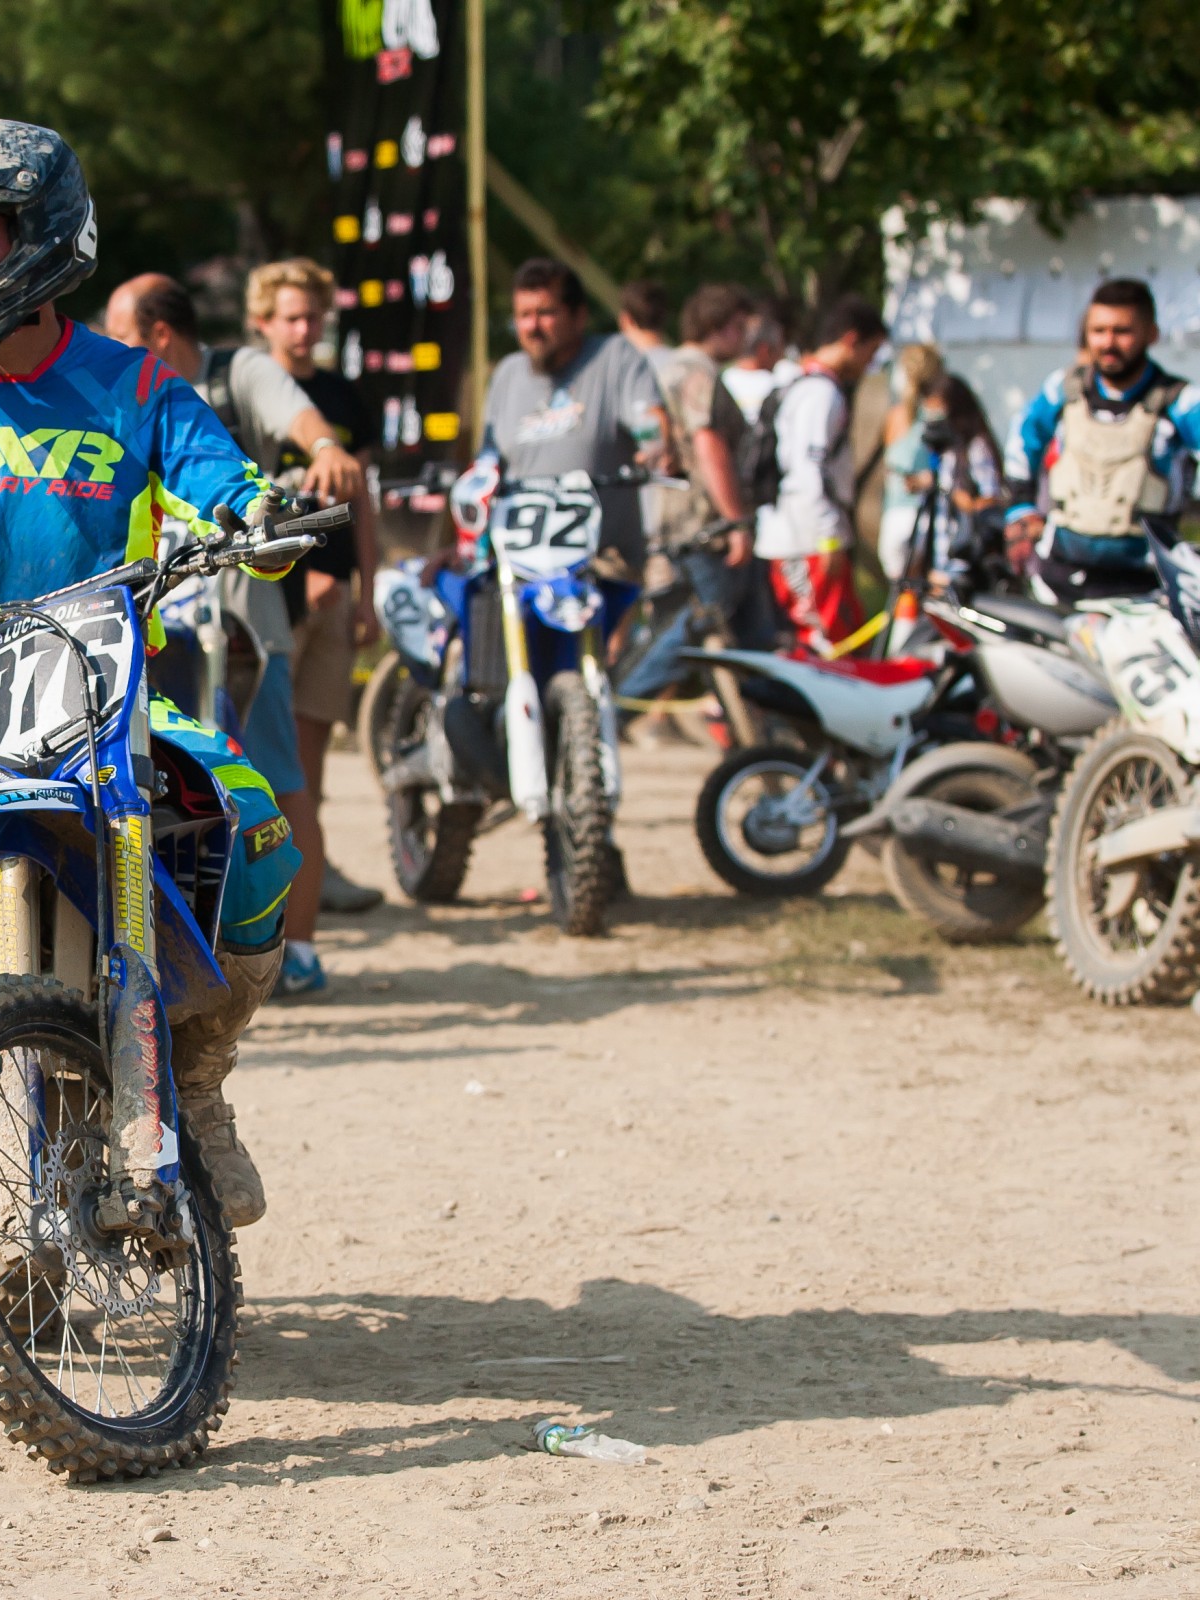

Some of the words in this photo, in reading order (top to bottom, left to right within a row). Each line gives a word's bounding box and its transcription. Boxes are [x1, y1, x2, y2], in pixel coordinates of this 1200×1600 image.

[46, 479, 116, 500] RIDE
[504, 504, 593, 552] 92
[55, 602, 82, 624] OIL
[254, 815, 292, 853] FXR
